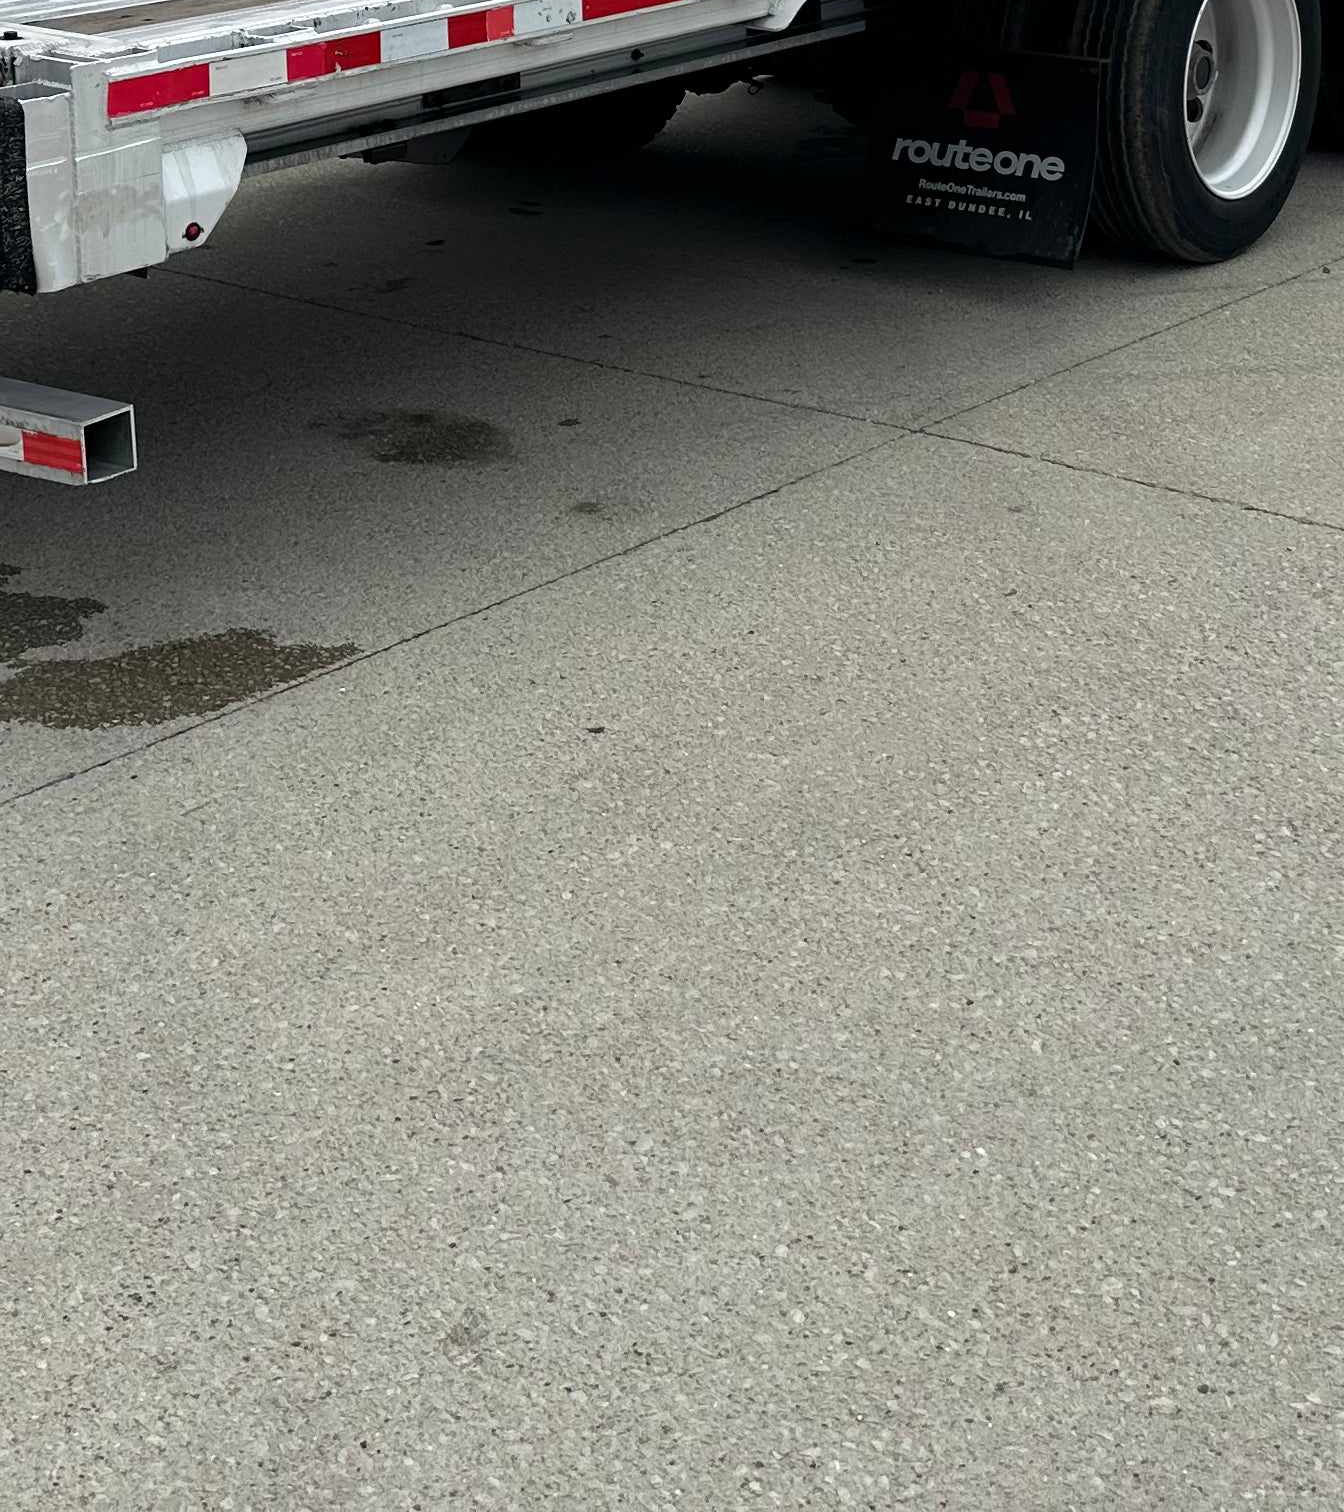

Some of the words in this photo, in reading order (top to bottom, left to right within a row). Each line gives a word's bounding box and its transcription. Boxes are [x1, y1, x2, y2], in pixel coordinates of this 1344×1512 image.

[891, 137, 1066, 183] routeone
[918, 178, 1027, 203] RouteOneTrailers.com
[905, 194, 942, 208] EAST
[947, 200, 1012, 219] DUNDEE,
[1018, 209, 1033, 221] IL
